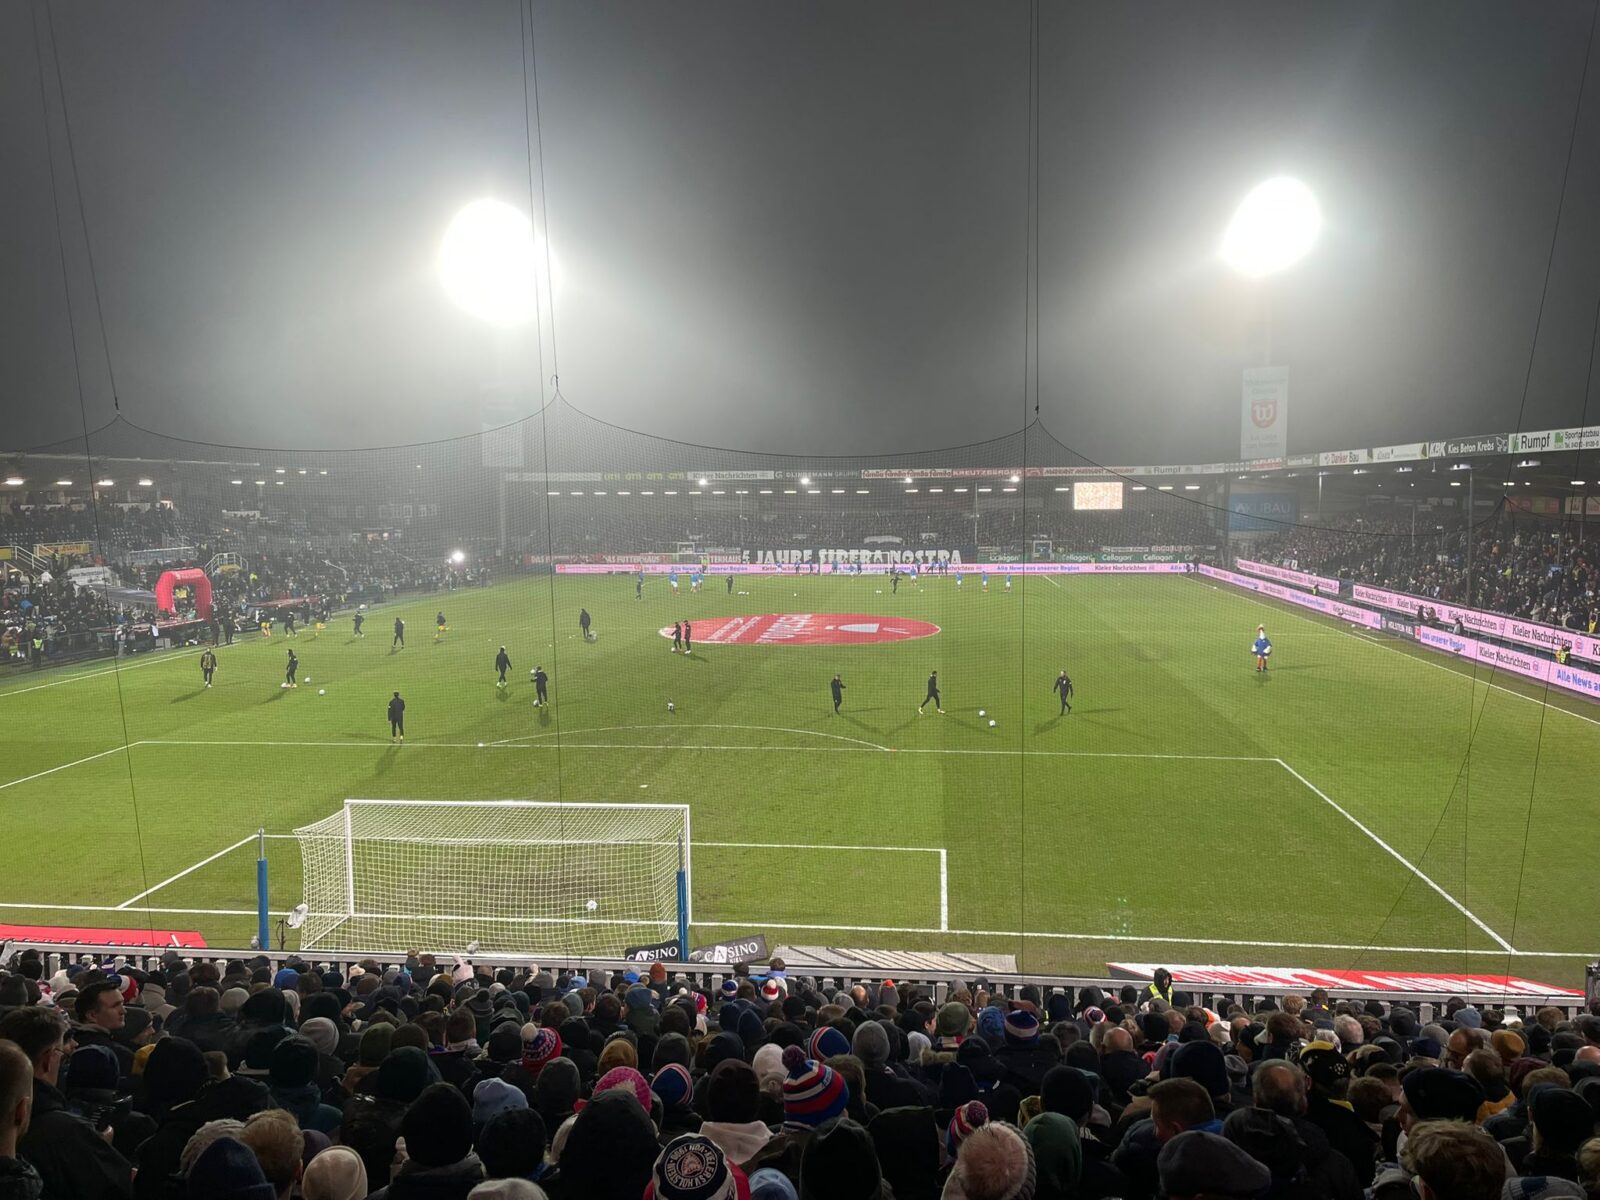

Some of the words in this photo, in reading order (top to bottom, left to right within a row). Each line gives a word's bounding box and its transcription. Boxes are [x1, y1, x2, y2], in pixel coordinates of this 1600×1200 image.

[1429, 442, 1446, 457] KBK
[1448, 444, 1459, 454] Kies
[1461, 443, 1476, 453] Beton
[1477, 440, 1494, 451] Krebs
[1521, 432, 1550, 449] Rumpf
[756, 550, 812, 564] JAHRE
[890, 550, 962, 564] NOSTRA
[1448, 610, 1463, 622] Kieler
[1464, 614, 1497, 630] Nachrichten
[1512, 624, 1531, 639] Kieler
[1532, 629, 1572, 648] Nachrichten
[1479, 647, 1496, 659] Kieler
[1496, 651, 1530, 671] Nachrichten
[1557, 669, 1571, 684] Alle
[1572, 673, 1592, 690] News
[705, 942, 758, 963] CASINO
[695, 1175, 707, 1187] SV
